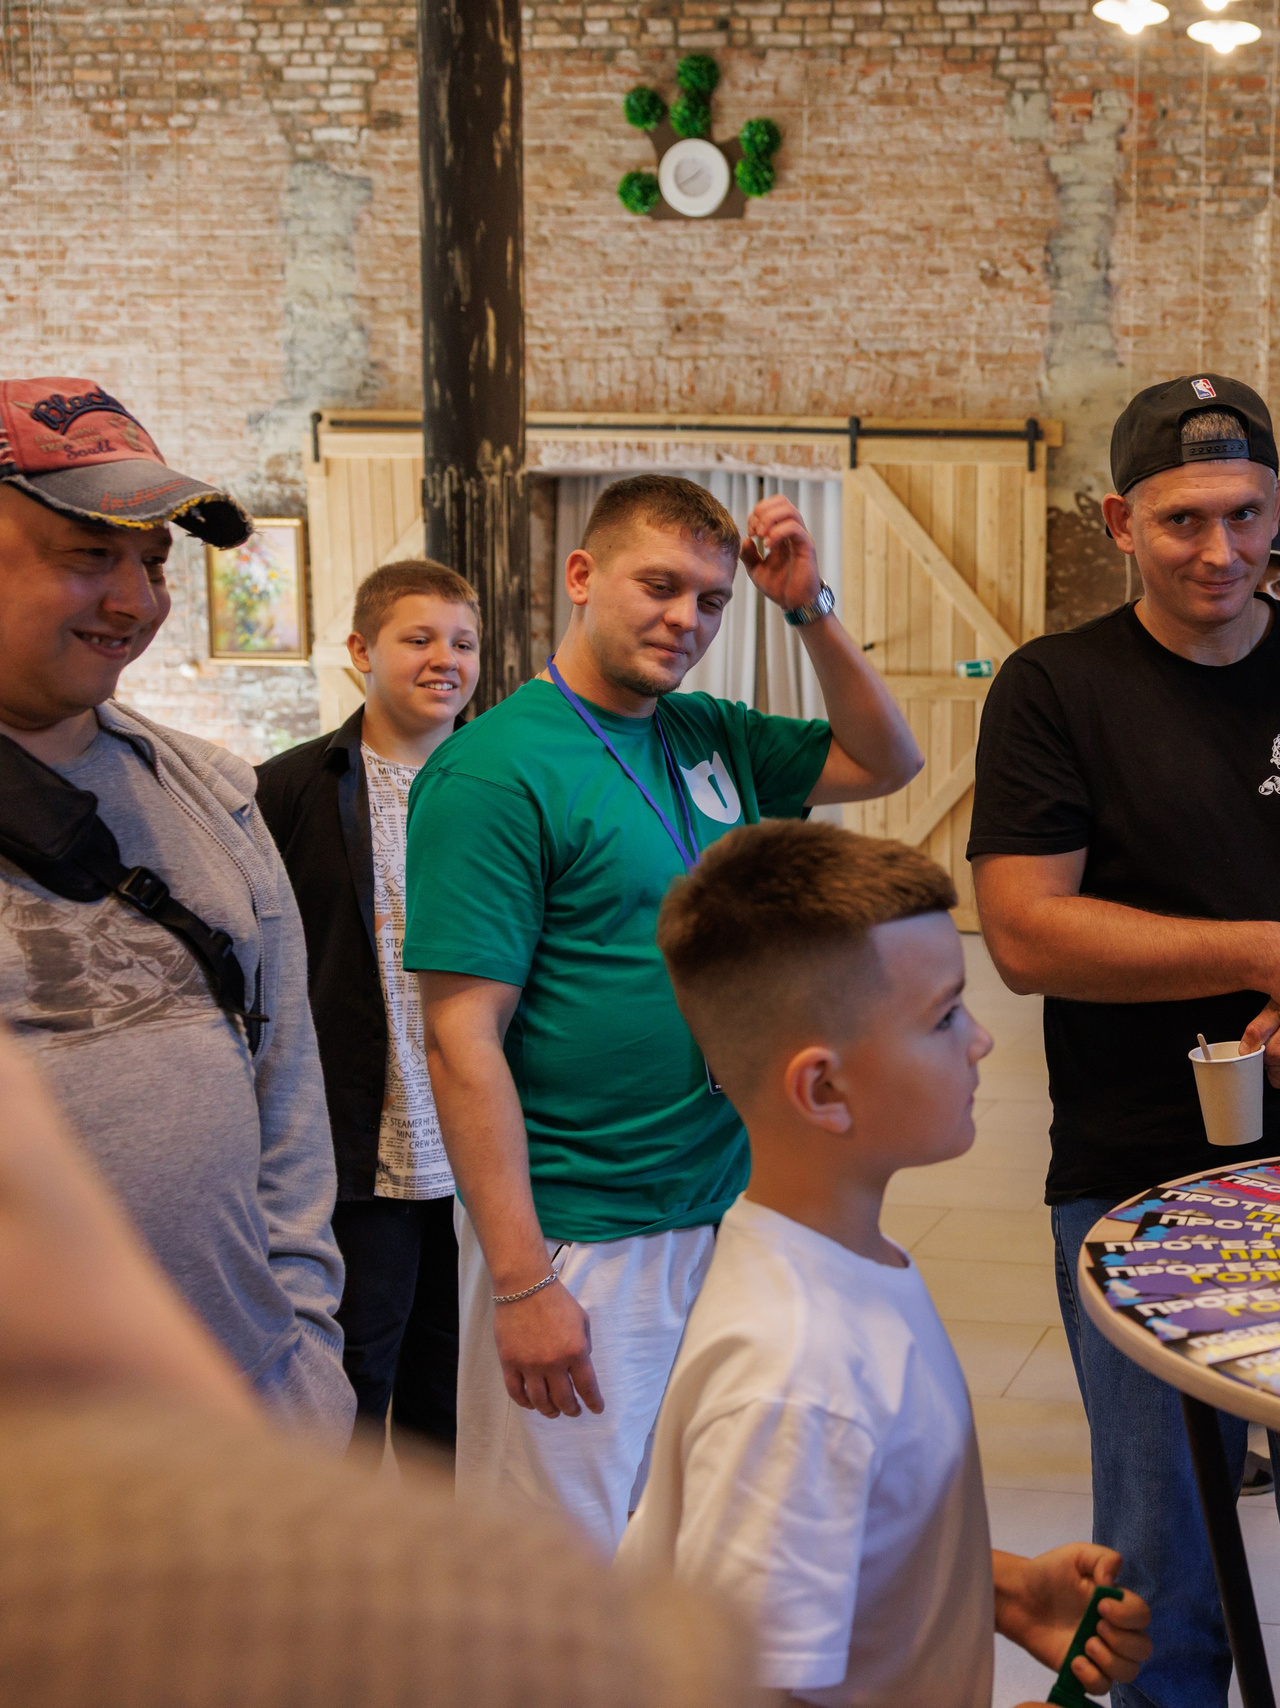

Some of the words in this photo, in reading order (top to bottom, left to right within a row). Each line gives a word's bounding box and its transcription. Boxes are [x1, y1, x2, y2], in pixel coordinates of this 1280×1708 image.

[396, 778, 412, 787] CRE
[409, 1140, 430, 1150] CREW
[1103, 1239, 1276, 1253] ПРОТЕЗ
